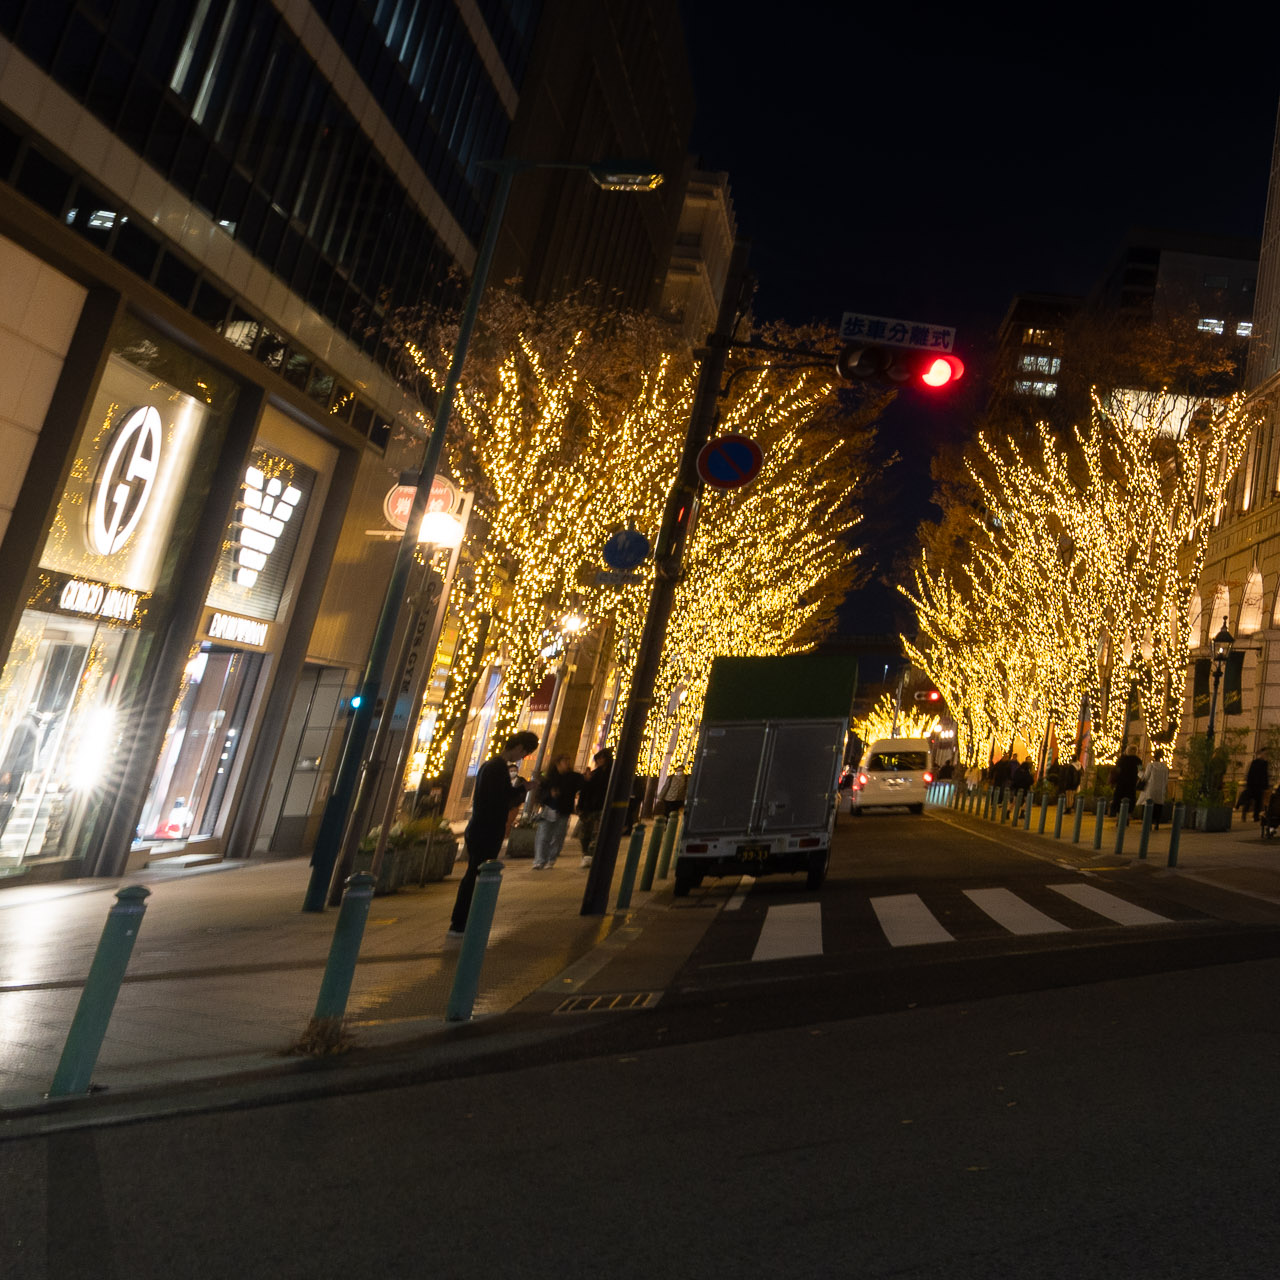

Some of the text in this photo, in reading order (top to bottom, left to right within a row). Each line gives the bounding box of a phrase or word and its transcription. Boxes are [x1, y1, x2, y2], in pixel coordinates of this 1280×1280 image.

[843, 316, 952, 350] 歩車分離式
